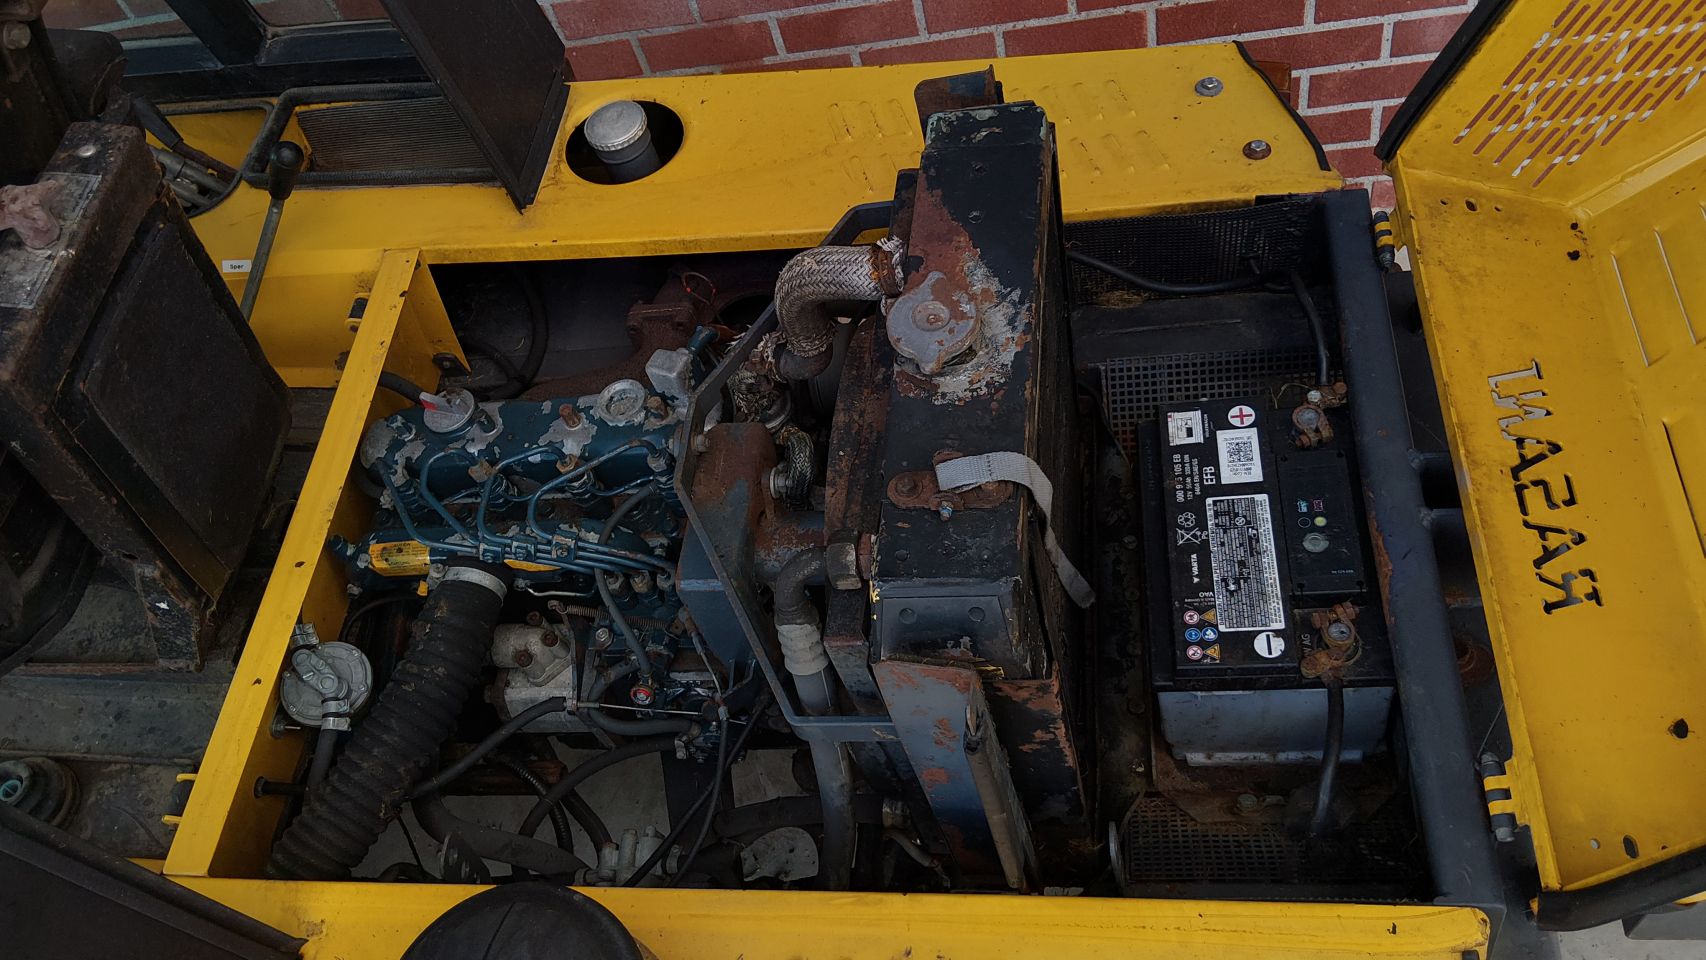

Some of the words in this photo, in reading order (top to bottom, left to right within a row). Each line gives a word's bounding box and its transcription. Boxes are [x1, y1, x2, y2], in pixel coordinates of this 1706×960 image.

[1173, 453, 1181, 463] EB
[1174, 463, 1182, 475] 105
[1203, 466, 1216, 485] EFB
[1202, 530, 1209, 540] Pb
[1191, 553, 1199, 576] VARTA
